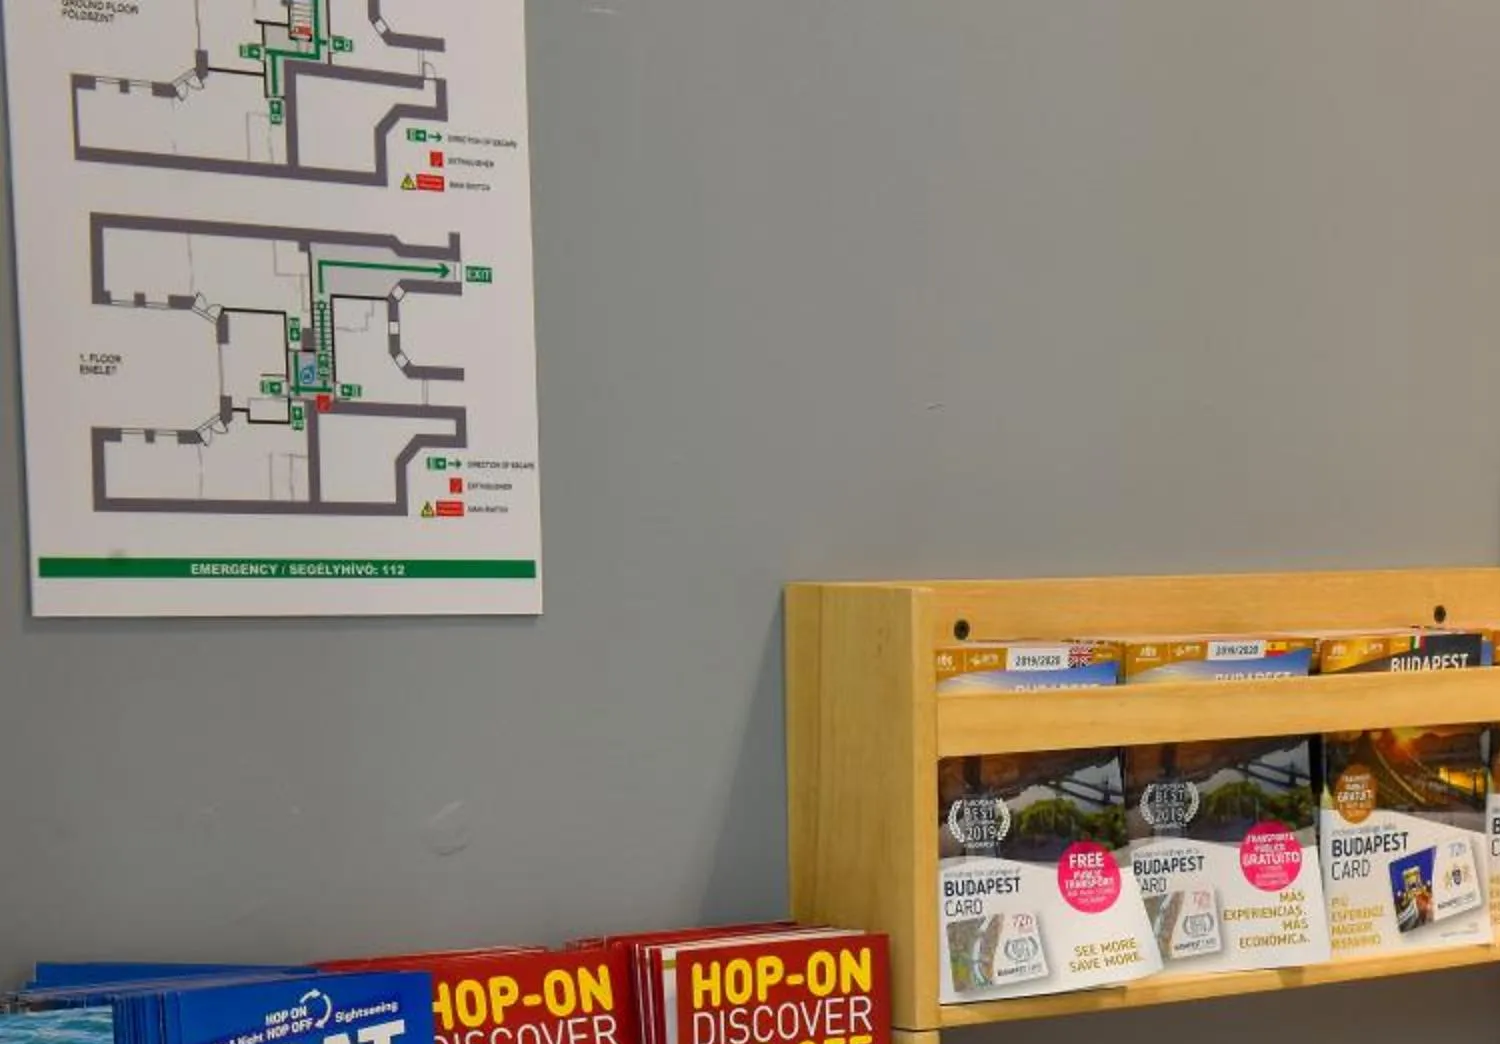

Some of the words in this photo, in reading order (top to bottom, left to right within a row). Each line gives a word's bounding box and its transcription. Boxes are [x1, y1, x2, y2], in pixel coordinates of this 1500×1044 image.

[466, 268, 492, 281] EXIT
[190, 563, 279, 576] EMERGENCY
[382, 564, 406, 577] 112
[1015, 654, 1062, 668] 2019/2020
[1390, 653, 1469, 673] BUDAPEST
[1154, 791, 1185, 803] BEST
[963, 806, 995, 821] BEST
[1154, 806, 1186, 823] 2019
[966, 822, 998, 842] 2019
[1331, 831, 1409, 858] BUDAPEST
[1068, 853, 1105, 868] FREE
[1133, 855, 1206, 876] BUDAPEST
[1241, 851, 1300, 866] GRATUITO
[1331, 859, 1372, 881] CARD
[943, 877, 1022, 897] BUDAPEST
[944, 899, 983, 917] CARD
[1073, 943, 1098, 957] SEE
[1100, 938, 1138, 953] MORE
[1068, 957, 1101, 973] SAVE
[690, 946, 873, 1010] HOP-ON
[432, 963, 614, 1031] HOP-ON
[265, 1010, 289, 1026] HOP
[290, 1005, 308, 1019] ON
[334, 1001, 399, 1023] Sightseeing
[266, 1025, 289, 1041] HOP
[291, 1016, 315, 1034] OFF
